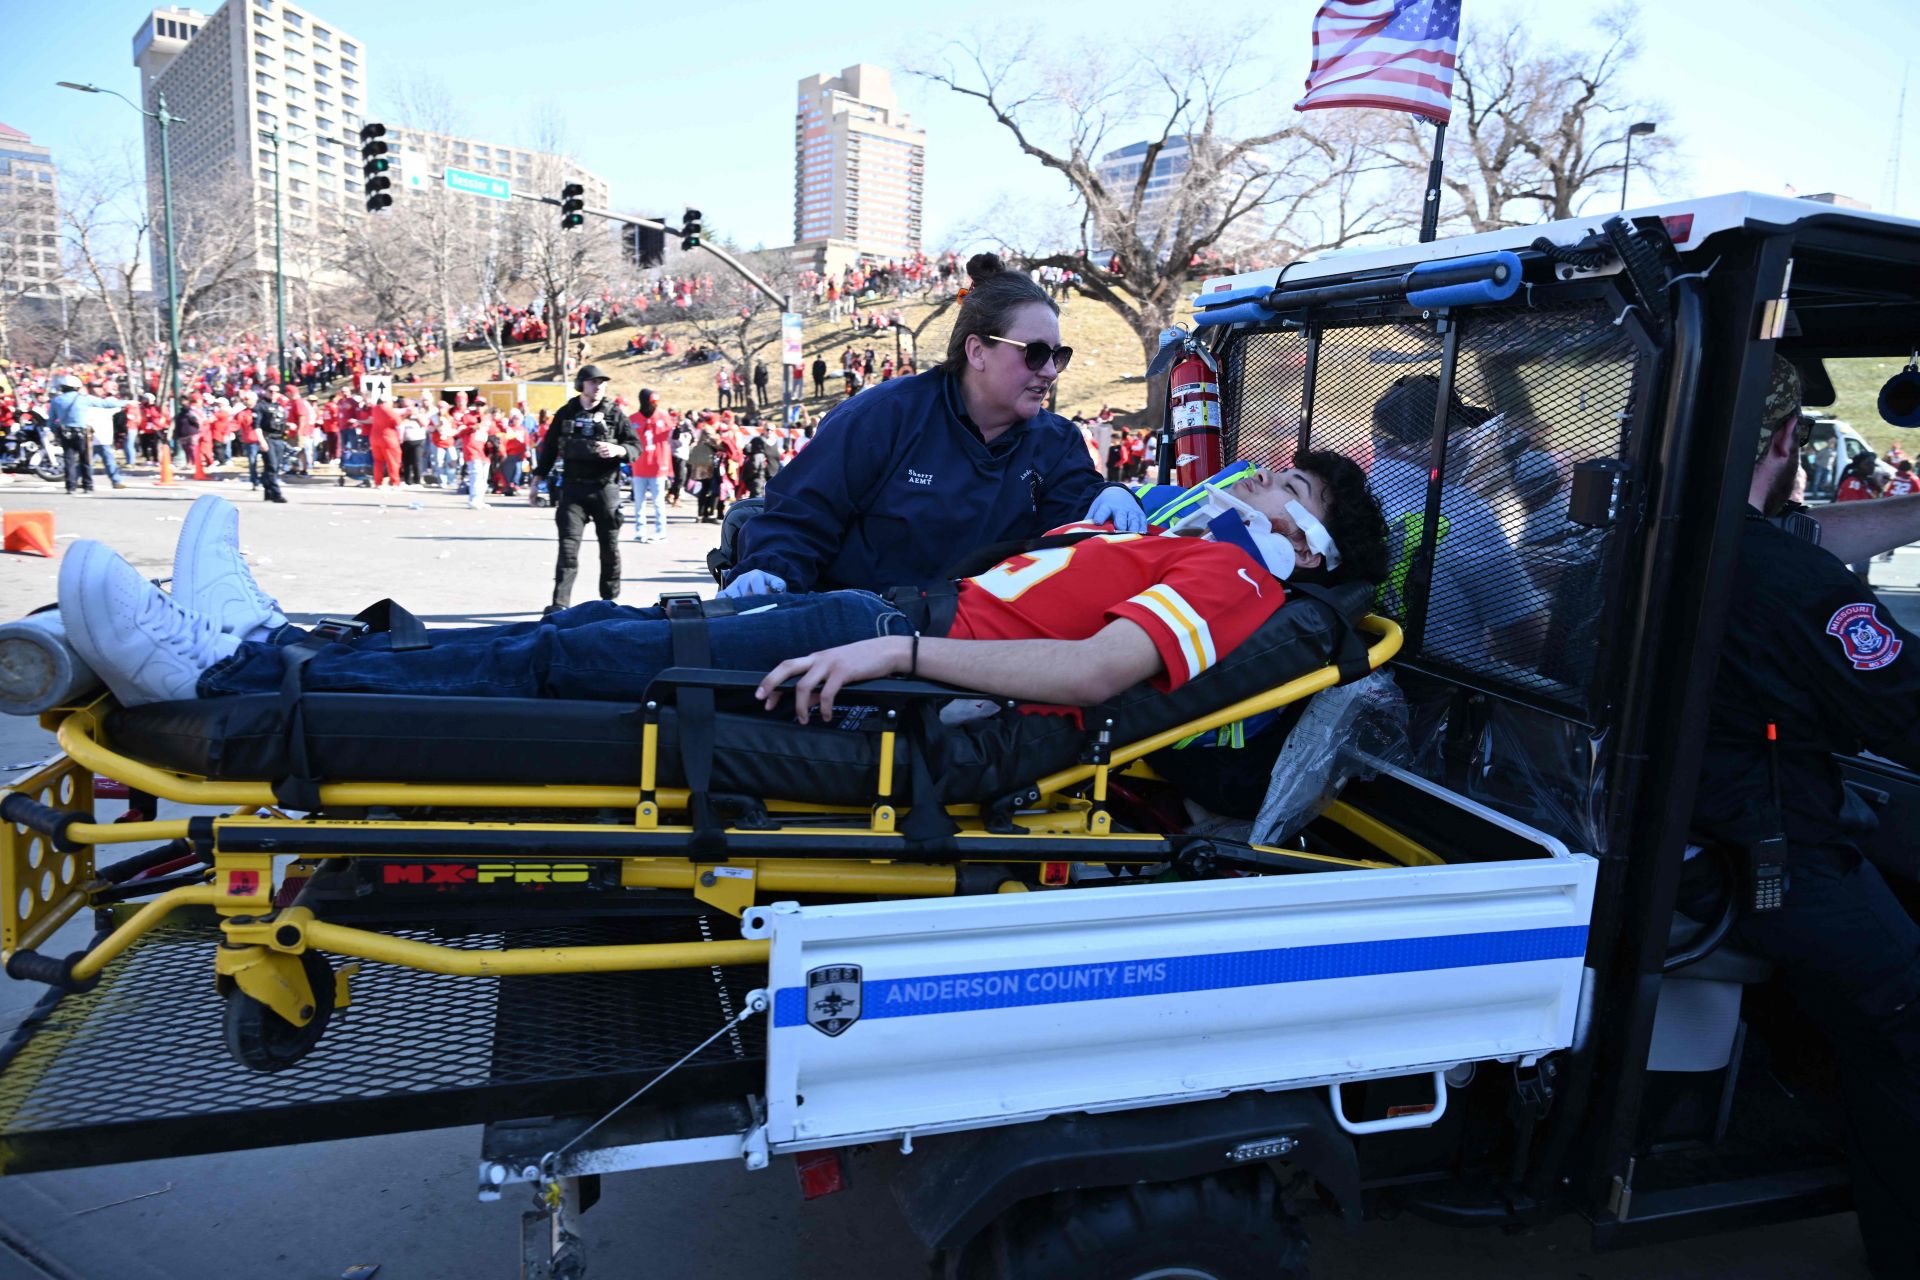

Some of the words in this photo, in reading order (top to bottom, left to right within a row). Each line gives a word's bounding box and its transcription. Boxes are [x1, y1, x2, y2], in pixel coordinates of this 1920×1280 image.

[908, 469, 933, 480] Sherry
[909, 477, 932, 485] AEMT
[1831, 606, 1869, 631] MISSOURI
[383, 864, 589, 884] MX-PRO
[885, 975, 1019, 1004] ANDERSON
[1026, 968, 1118, 992] COUNTY
[1123, 963, 1167, 984] EMS
